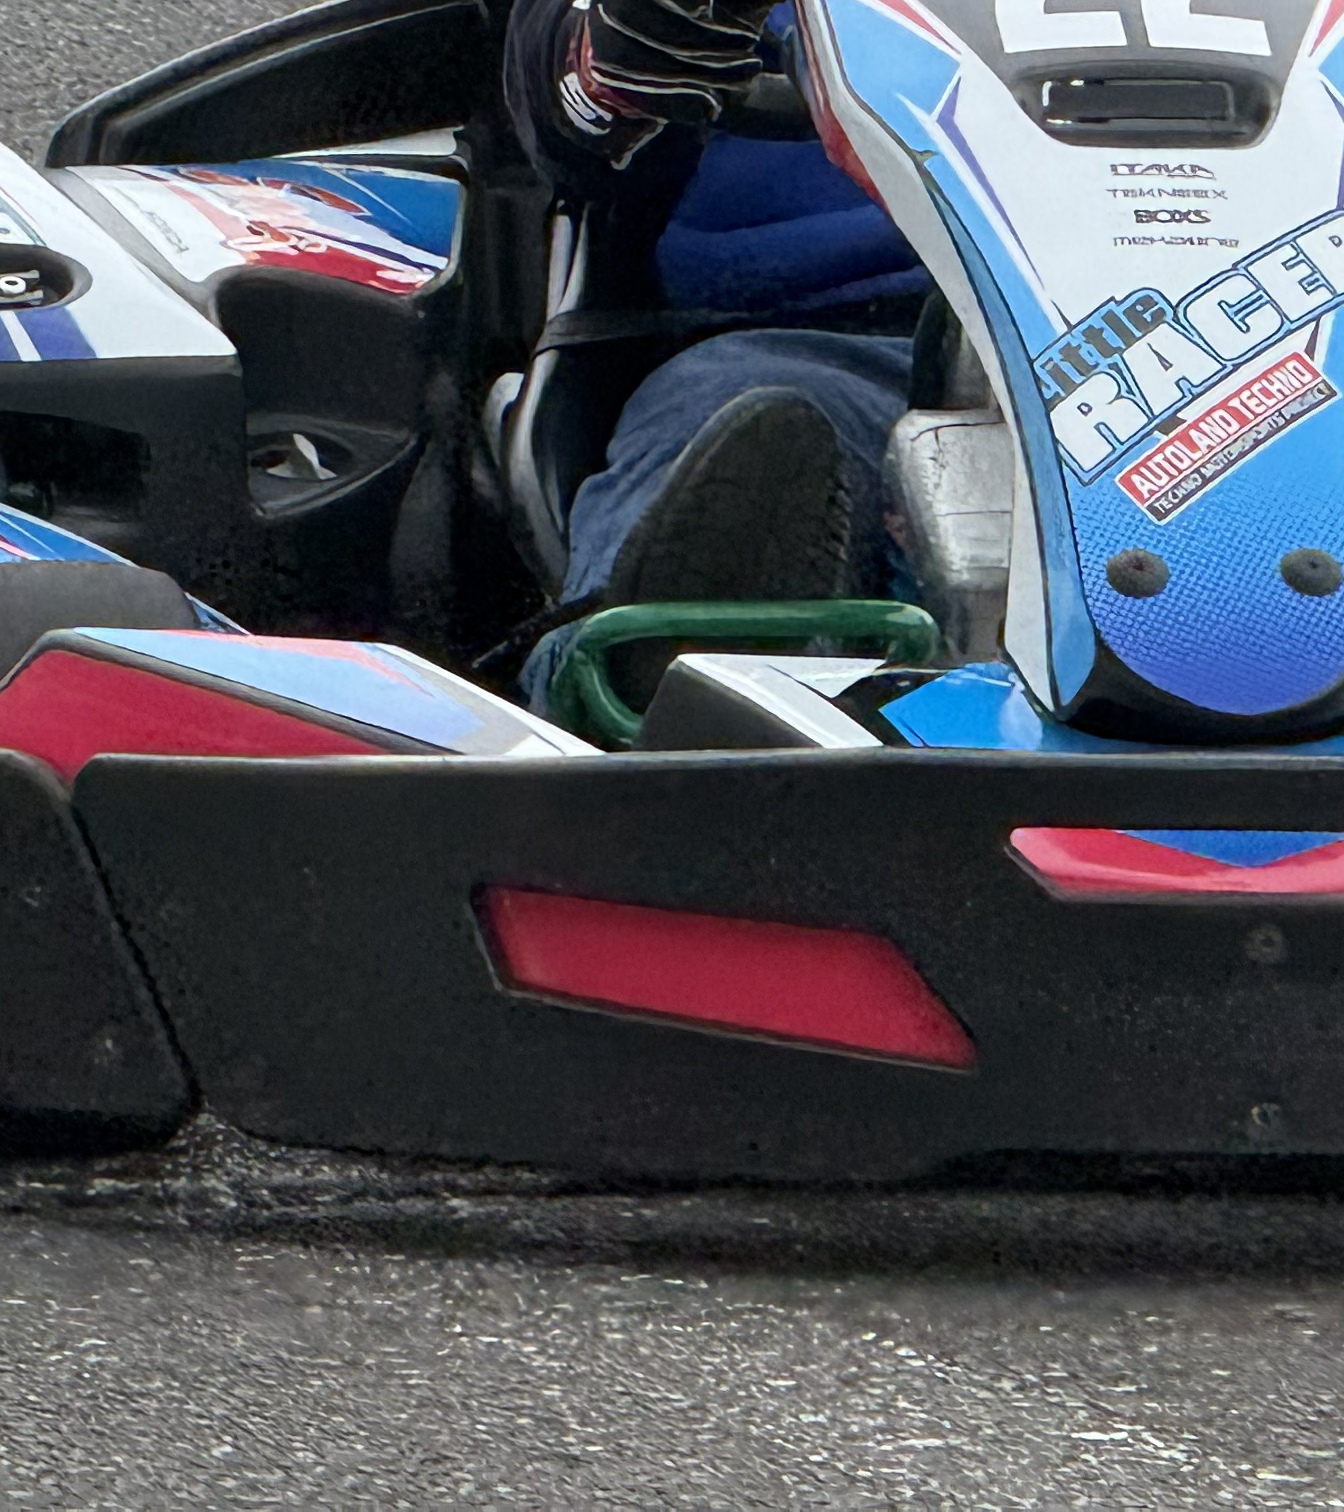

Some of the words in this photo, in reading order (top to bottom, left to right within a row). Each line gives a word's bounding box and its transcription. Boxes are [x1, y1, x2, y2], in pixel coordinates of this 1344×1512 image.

[1041, 294, 1167, 402] ittle
[1130, 409, 1241, 500] AUTOLAND
[1227, 359, 1314, 422] TECHNO
